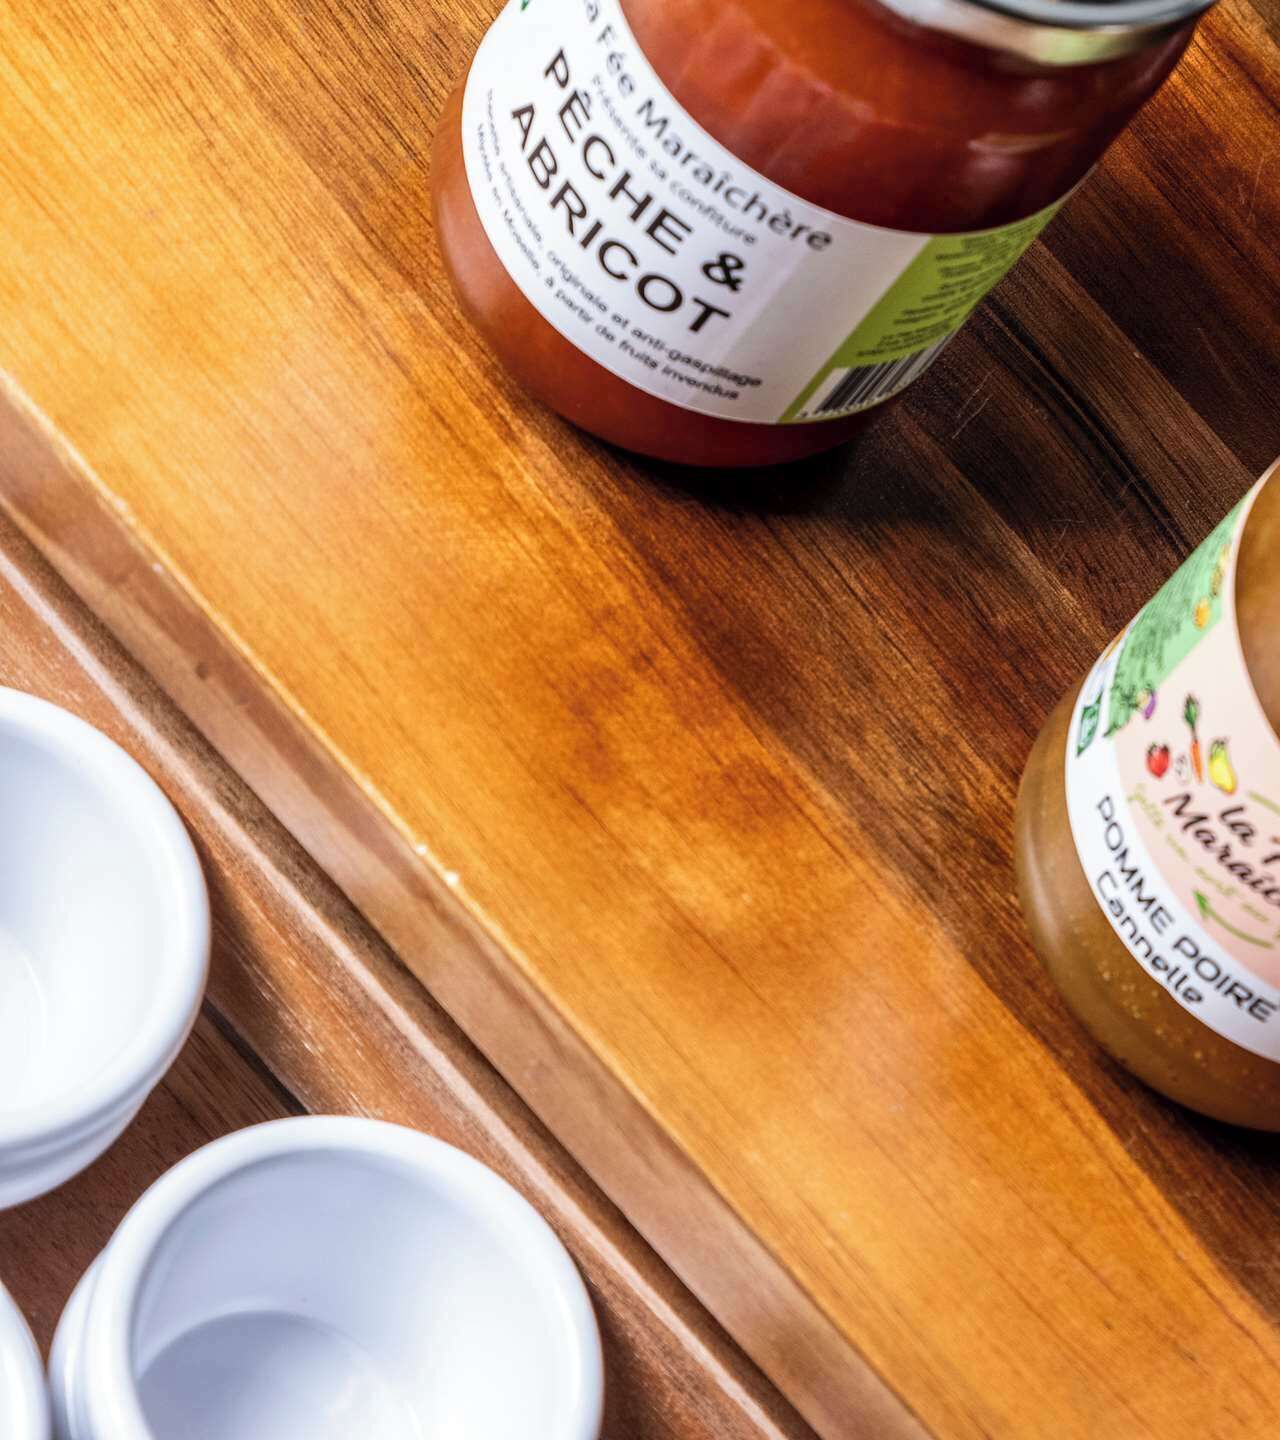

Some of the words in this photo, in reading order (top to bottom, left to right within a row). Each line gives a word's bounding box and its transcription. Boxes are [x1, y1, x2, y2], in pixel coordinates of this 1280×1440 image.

[543, 47, 694, 256] PÊCHE
[702, 251, 746, 294] &
[596, 23, 636, 97] Fée
[636, 99, 833, 252] Maraîchère
[511, 102, 731, 333] ABRICOT
[669, 176, 758, 245] confiture
[594, 322, 617, 343] de
[618, 338, 659, 371] fruits
[661, 364, 741, 401] invendus
[611, 312, 630, 331] et
[630, 327, 764, 388] anti-gaspillage
[1220, 805, 1256, 846] la
[1095, 870, 1206, 1007] Cannelle
[1096, 795, 1177, 936] POMME
[1172, 934, 1280, 1024] POIRE
